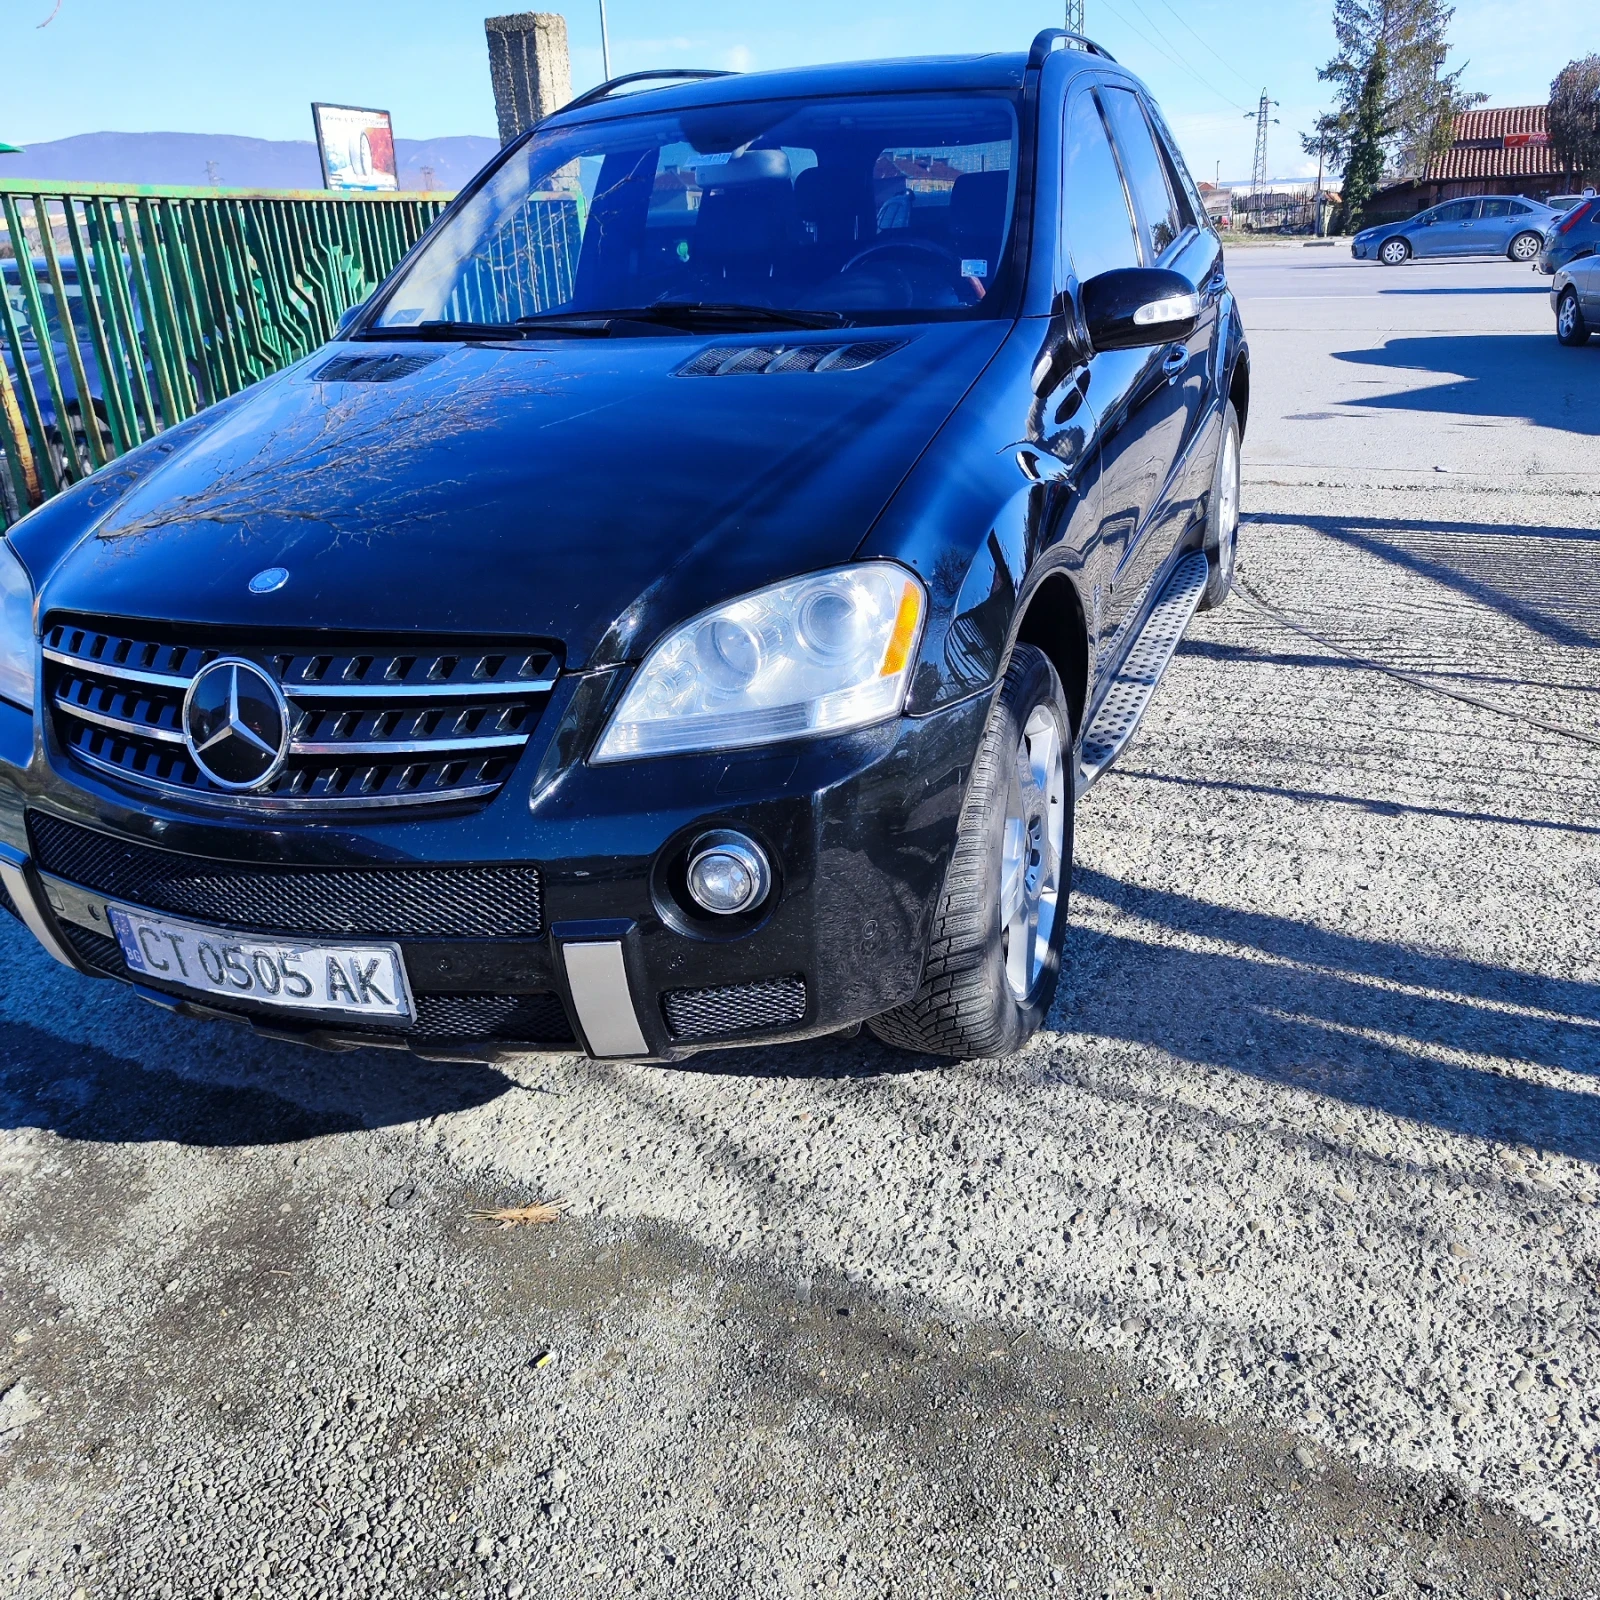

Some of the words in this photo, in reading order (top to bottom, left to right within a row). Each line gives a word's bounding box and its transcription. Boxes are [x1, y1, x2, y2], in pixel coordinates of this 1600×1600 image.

[125, 946, 142, 962] BG
[138, 924, 190, 978] CT
[197, 940, 315, 998] 0505
[325, 954, 400, 1006] AK
